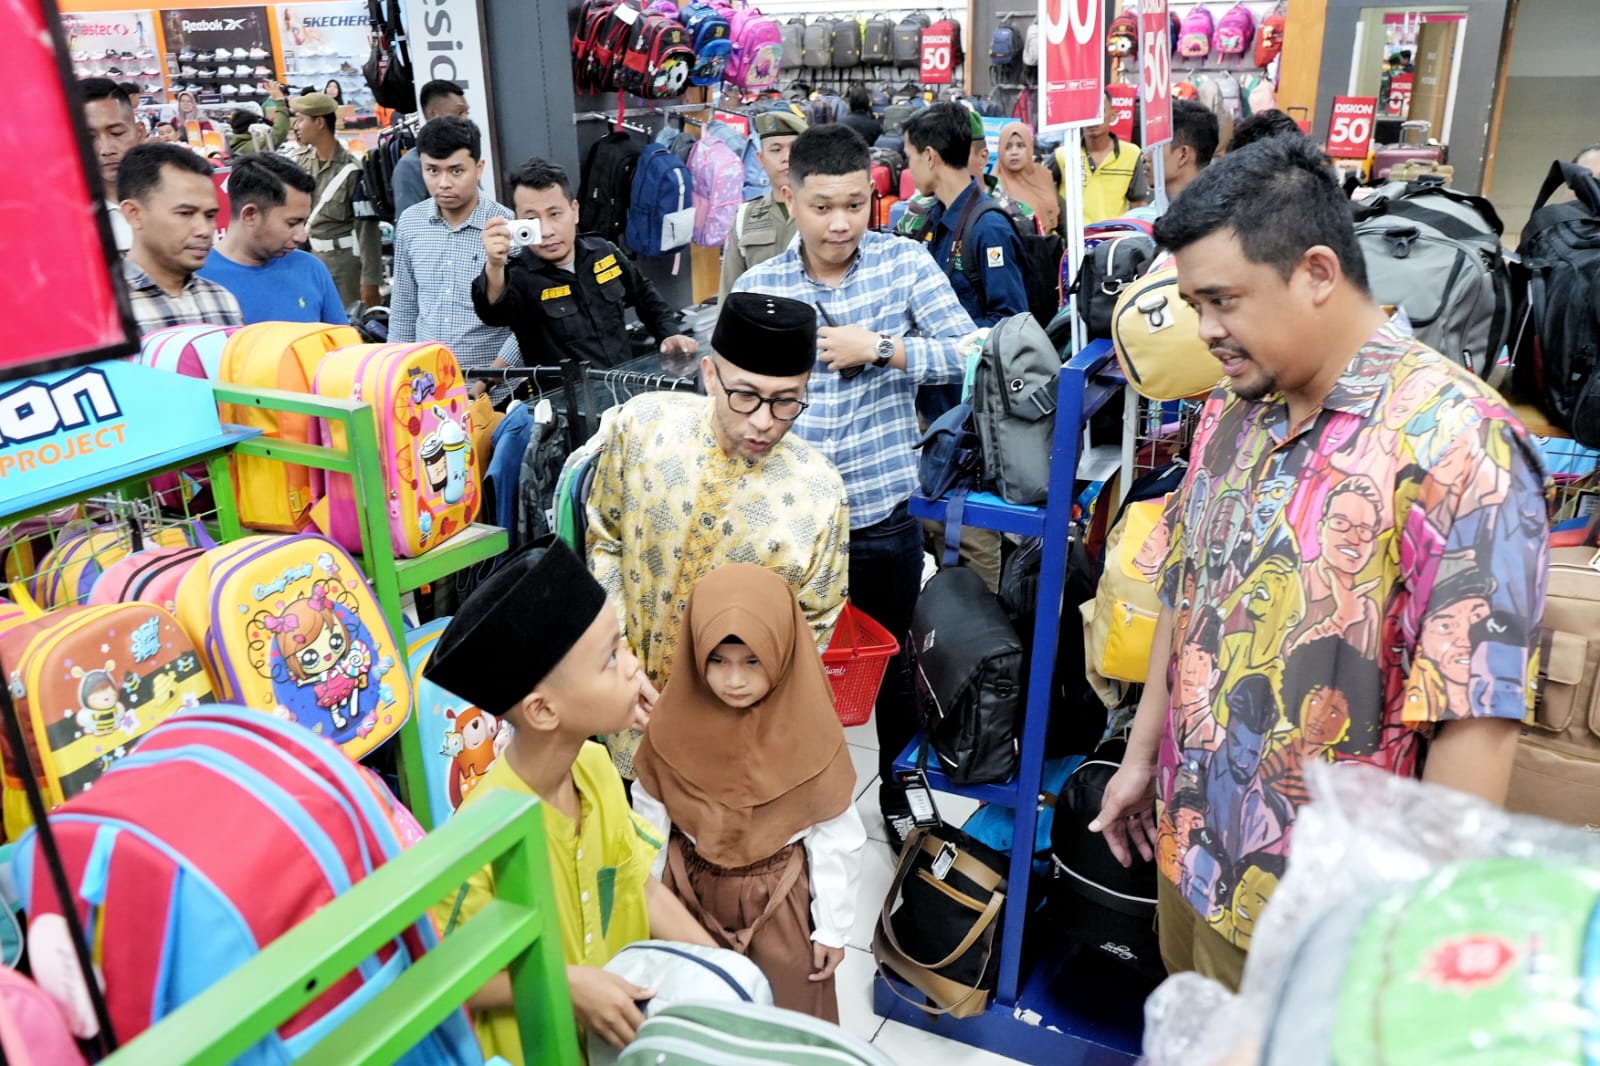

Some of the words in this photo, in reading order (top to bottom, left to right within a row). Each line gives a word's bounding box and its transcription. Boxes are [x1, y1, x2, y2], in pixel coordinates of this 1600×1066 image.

[182, 19, 223, 33] Reebok
[922, 47, 951, 71] 50
[1334, 103, 1374, 114] DISKON
[0, 366, 123, 449] on
[0, 423, 127, 478] PROJECT
